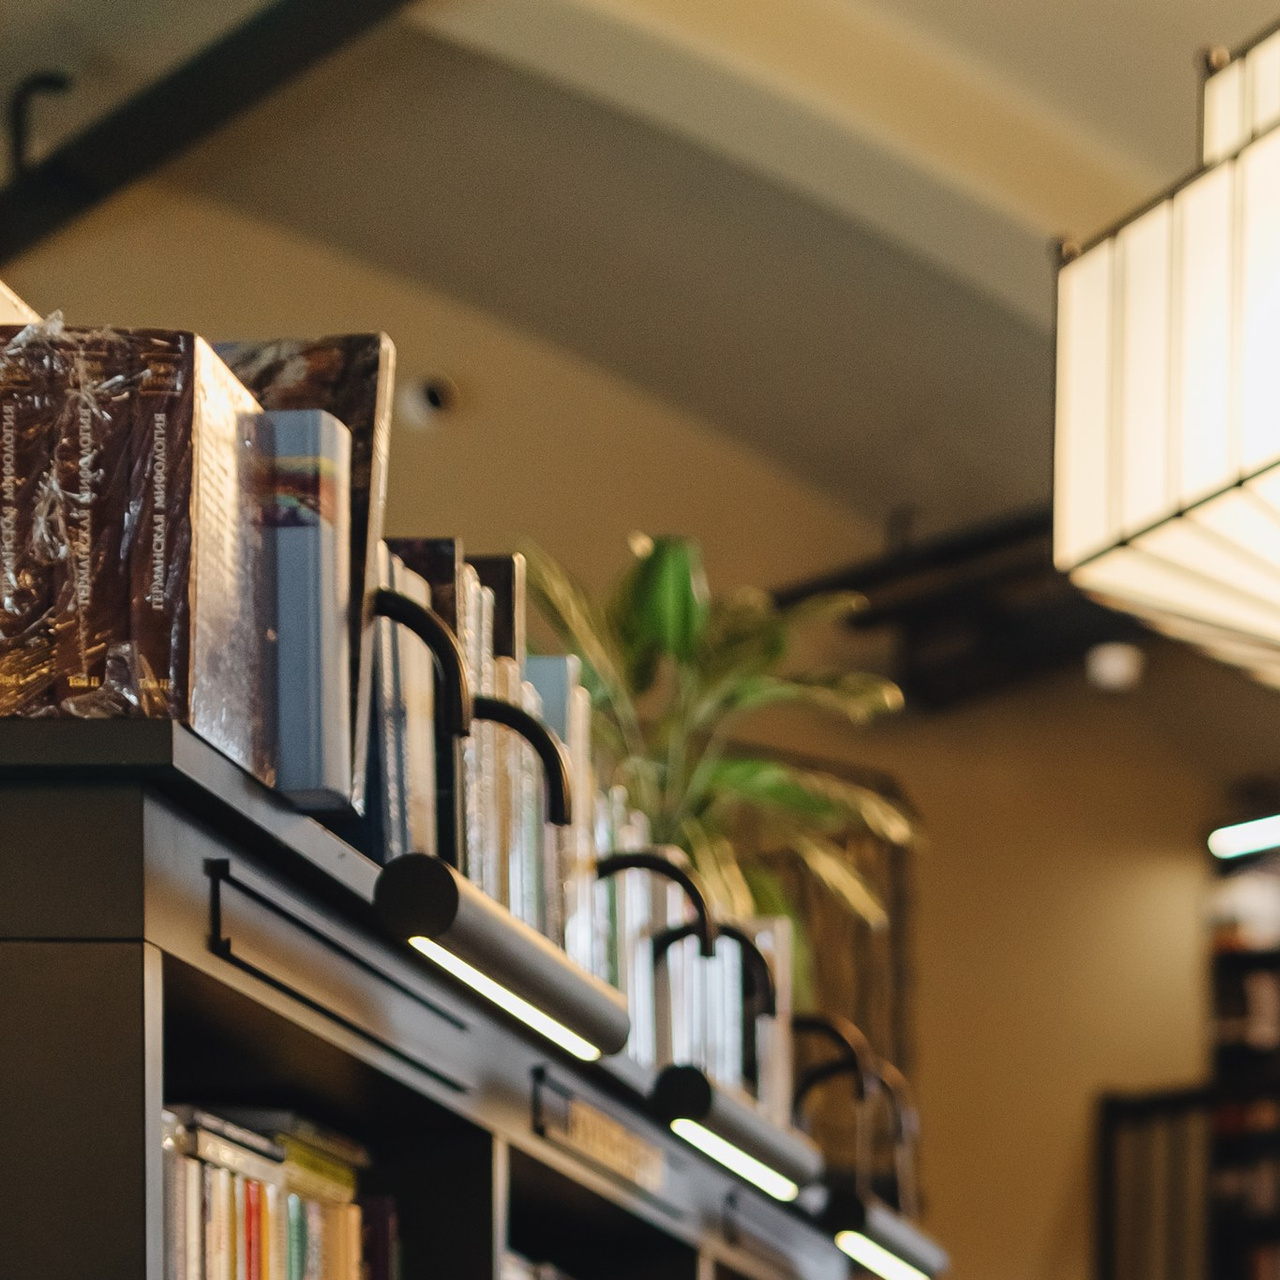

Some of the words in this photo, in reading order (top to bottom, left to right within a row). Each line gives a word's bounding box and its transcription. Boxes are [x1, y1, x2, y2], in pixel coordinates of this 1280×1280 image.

[2, 405, 15, 501] МИФОЛОГИЯ
[153, 413, 166, 509] МИФОЛОГИЯ
[152, 514, 166, 610] ГЕРМАНСКАЯ
